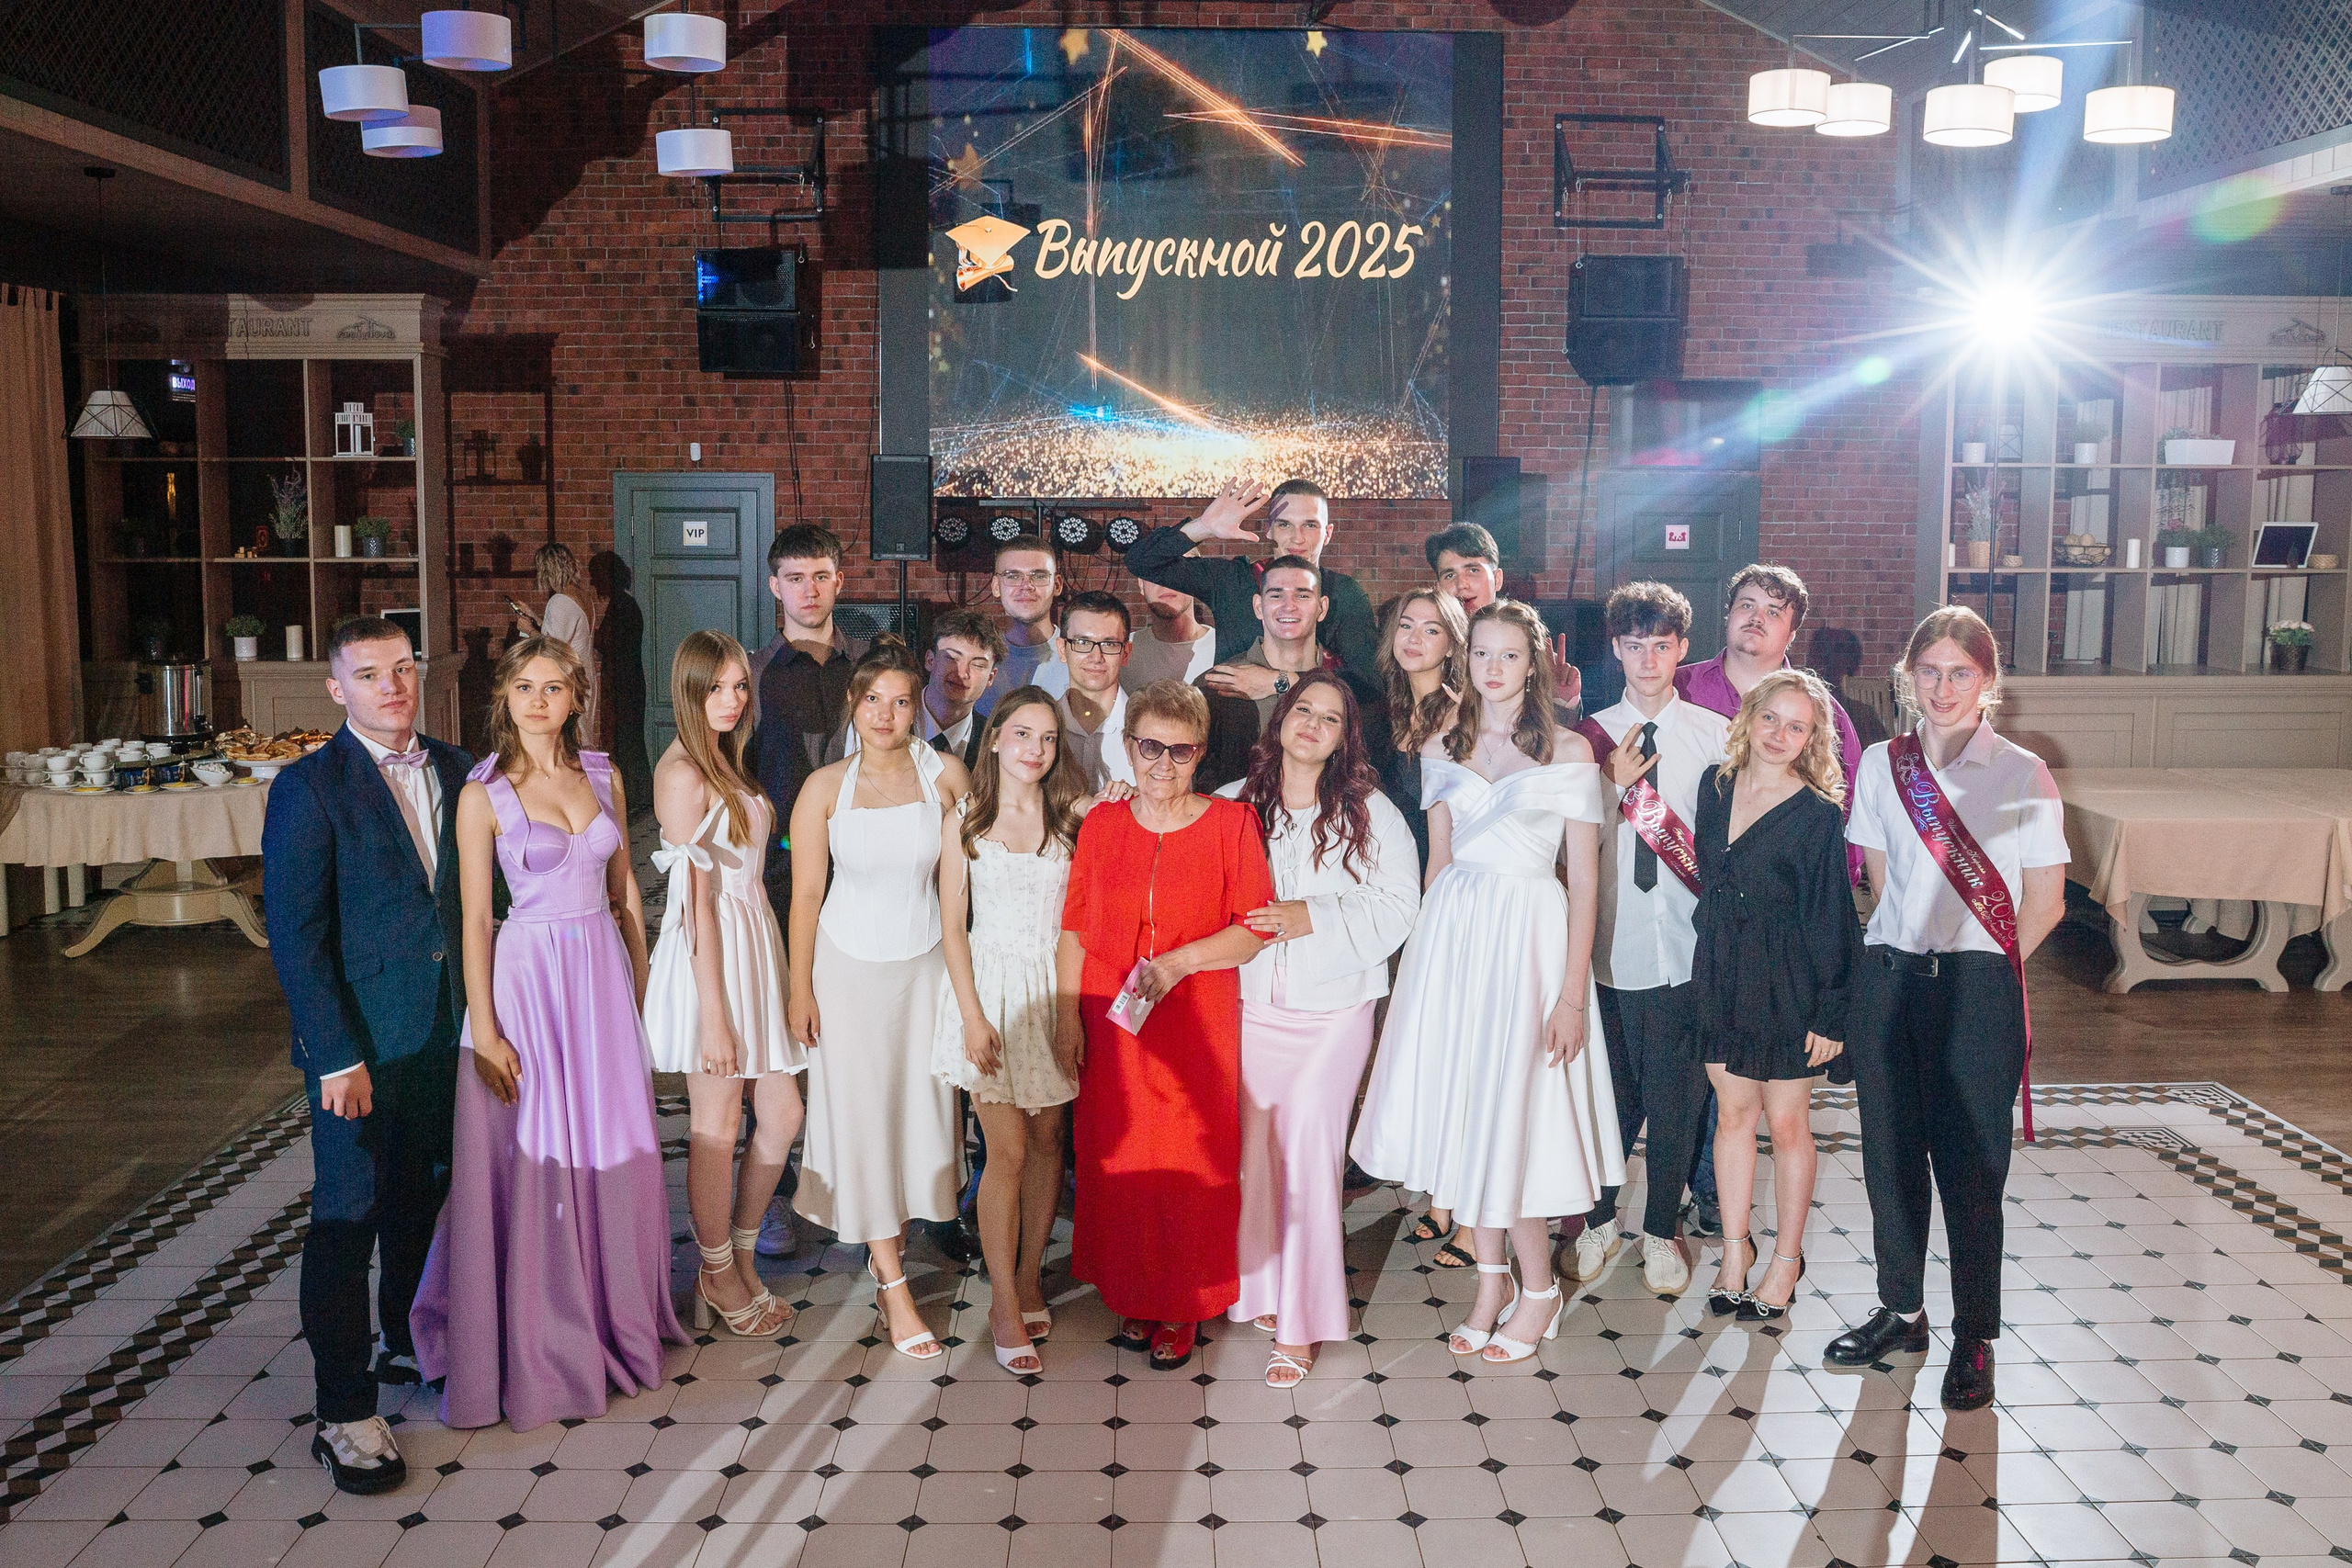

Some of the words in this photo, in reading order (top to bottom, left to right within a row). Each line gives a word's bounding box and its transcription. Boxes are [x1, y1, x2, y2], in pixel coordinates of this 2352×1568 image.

[1294, 220, 1423, 279] 2025
[2097, 319, 2223, 341] RESTAURANT
[686, 528, 705, 537] VIP
[1634, 799, 1702, 884] Выпускни
[1907, 781, 1984, 889] Выпускник
